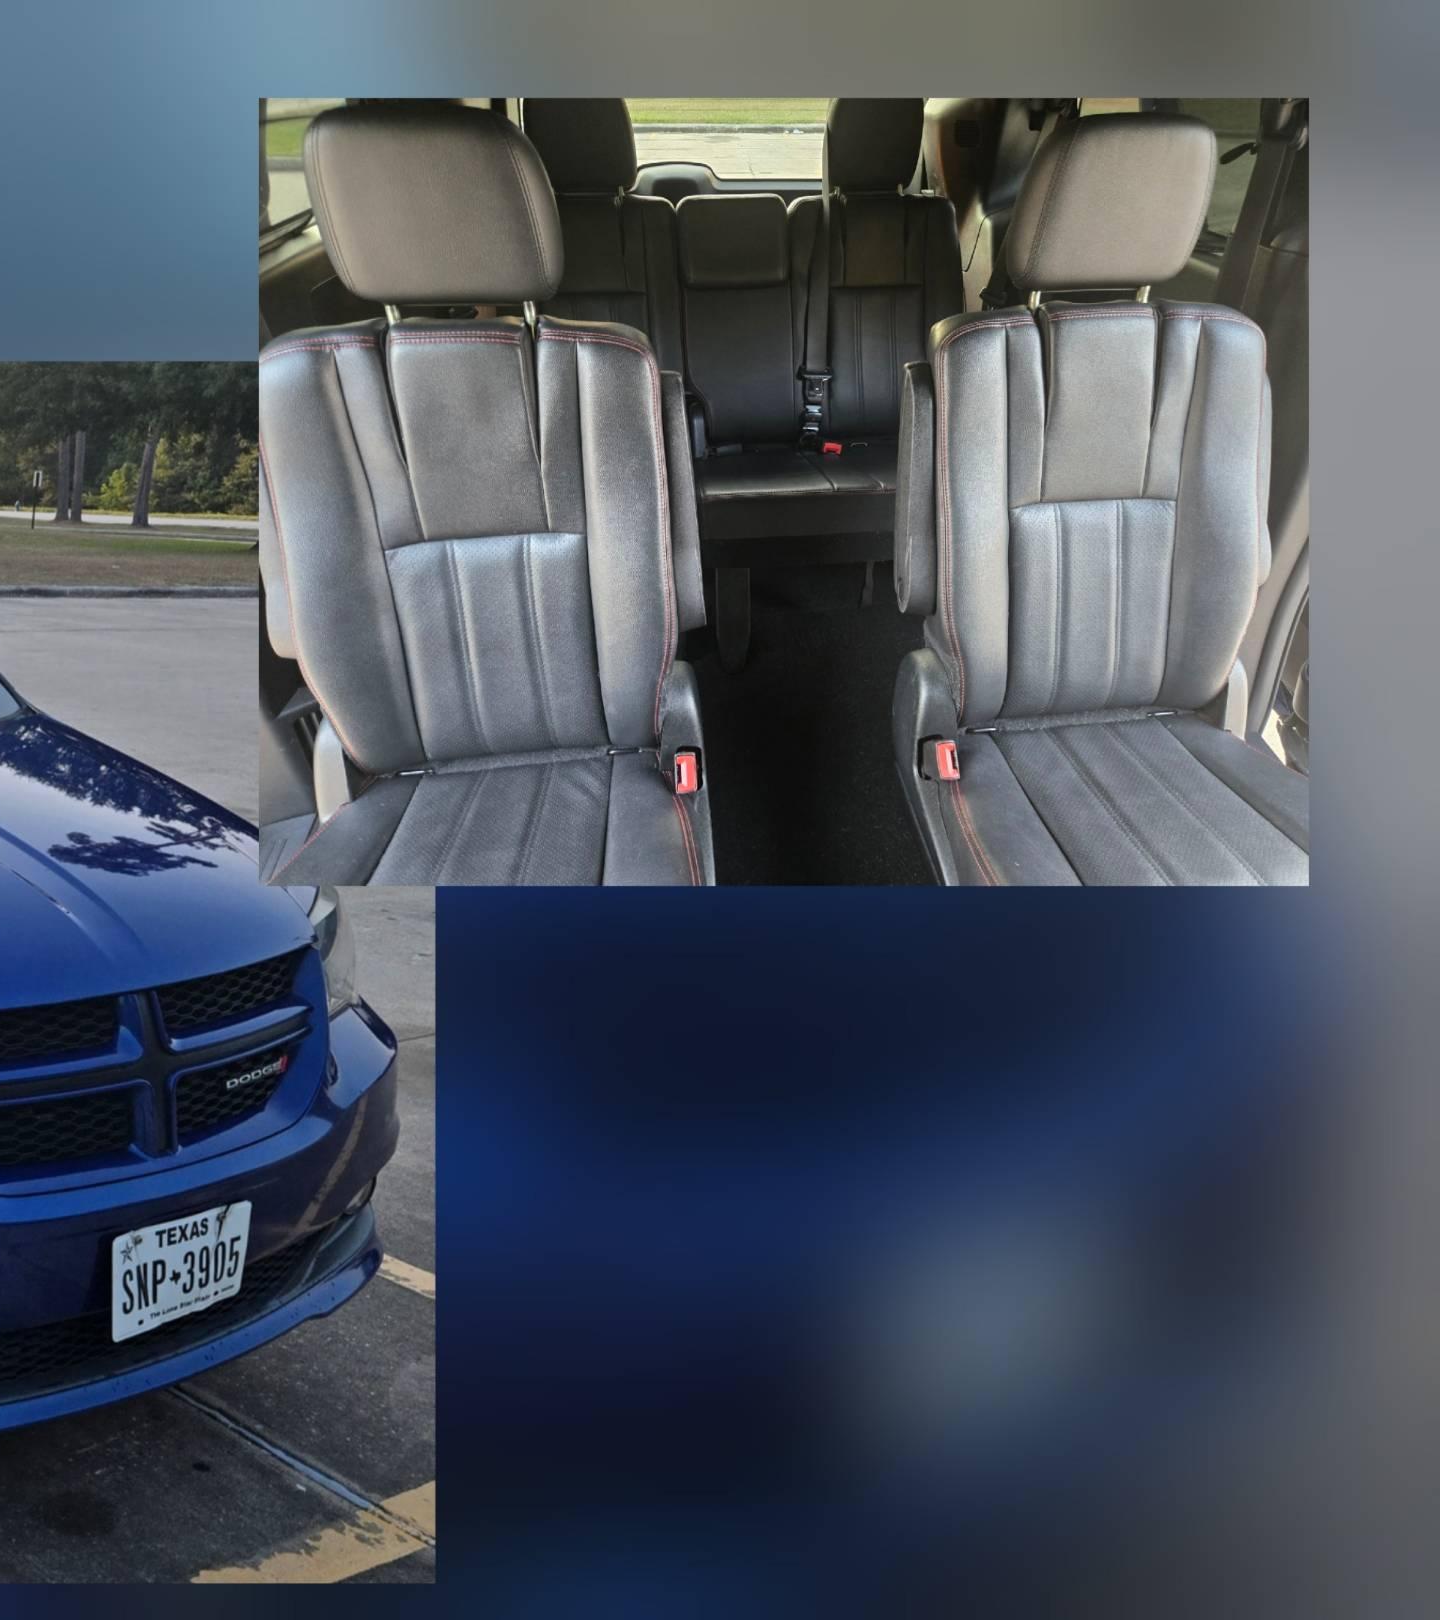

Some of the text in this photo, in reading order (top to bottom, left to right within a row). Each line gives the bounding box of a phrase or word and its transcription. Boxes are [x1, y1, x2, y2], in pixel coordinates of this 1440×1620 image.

[226, 1060, 282, 1090] DODGE
[155, 1217, 209, 1248] TEXAS
[122, 1236, 241, 1315] SNP 3905
